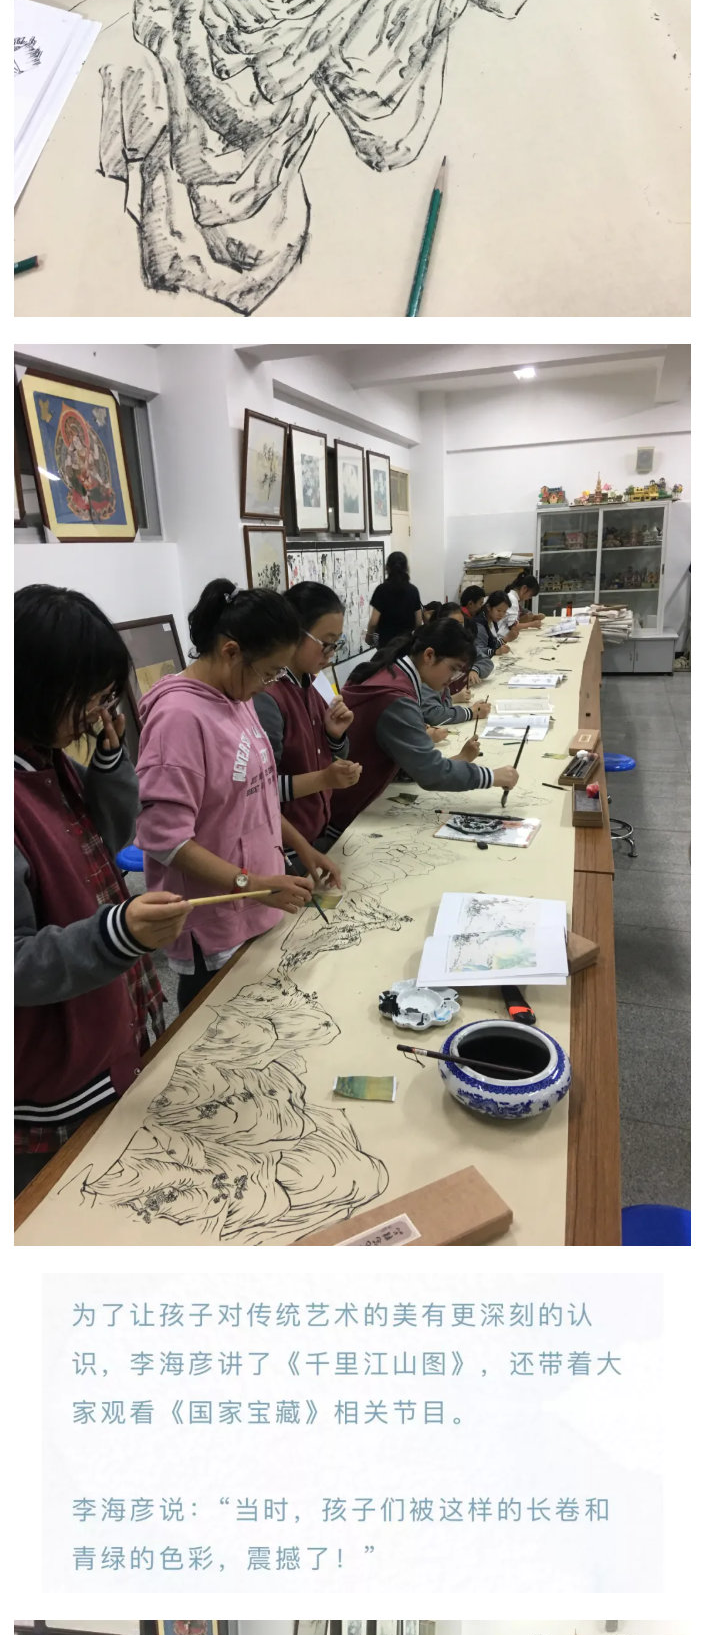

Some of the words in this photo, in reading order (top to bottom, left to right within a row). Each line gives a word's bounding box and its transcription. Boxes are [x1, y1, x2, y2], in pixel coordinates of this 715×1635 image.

[72, 1302, 592, 1328] 为了让孩子对传统艺术的美有更深刻的认
[72, 1350, 622, 1377] 识，李海彦讲了《千里江山图》，还带着大
[72, 1399, 466, 1425] 家观看《国家宝藏》相关节目。
[72, 1496, 610, 1523] 李海彦说：“当时，孩子们被这样的长卷和
[72, 1545, 376, 1572] 青绿的色彩，震撼了！”
